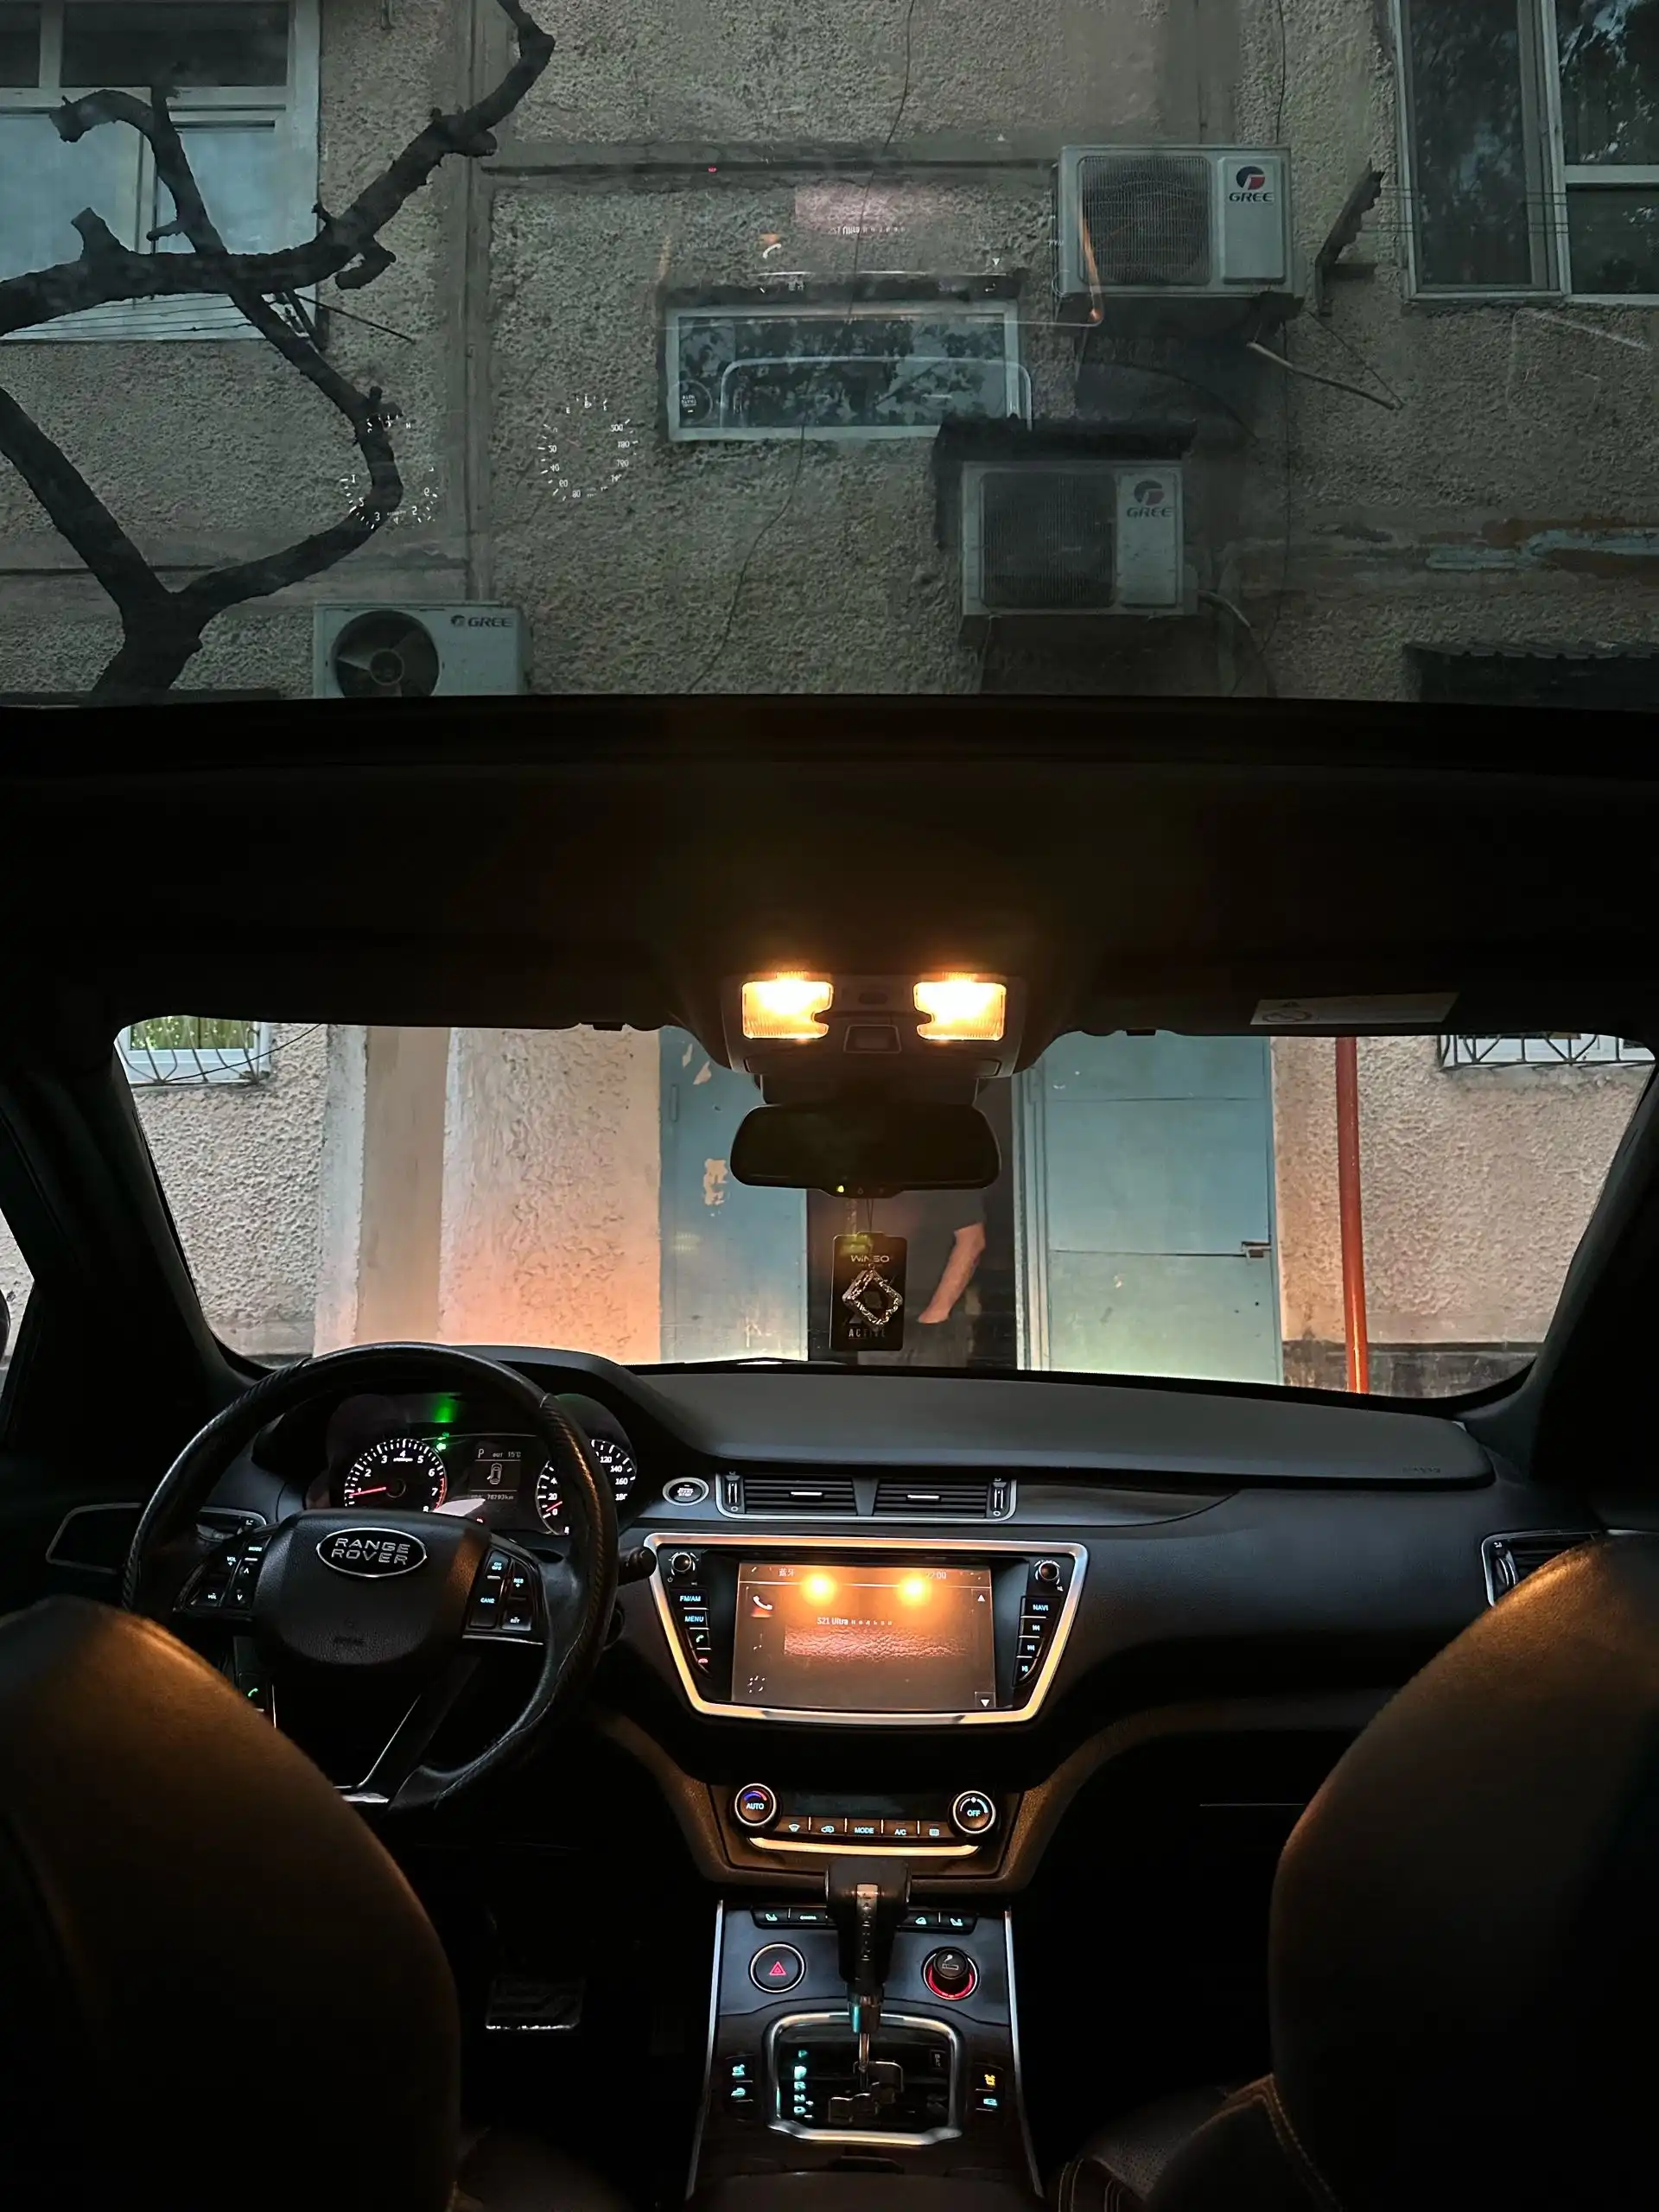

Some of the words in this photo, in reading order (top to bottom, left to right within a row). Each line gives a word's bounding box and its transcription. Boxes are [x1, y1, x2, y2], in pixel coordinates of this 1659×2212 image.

[1229, 192, 1274, 202] GREE
[1127, 507, 1173, 518] GREE
[467, 617, 514, 627] GREE
[478, 1448, 485, 1459] P
[381, 1455, 388, 1464] 3
[417, 1455, 424, 1464] 5
[364, 1469, 372, 1478] 2
[428, 1468, 435, 1478] 6
[431, 1487, 439, 1497] 7
[551, 1508, 558, 1516] 0
[335, 1538, 410, 1554] RANGE
[331, 1548, 408, 1565] ROVER
